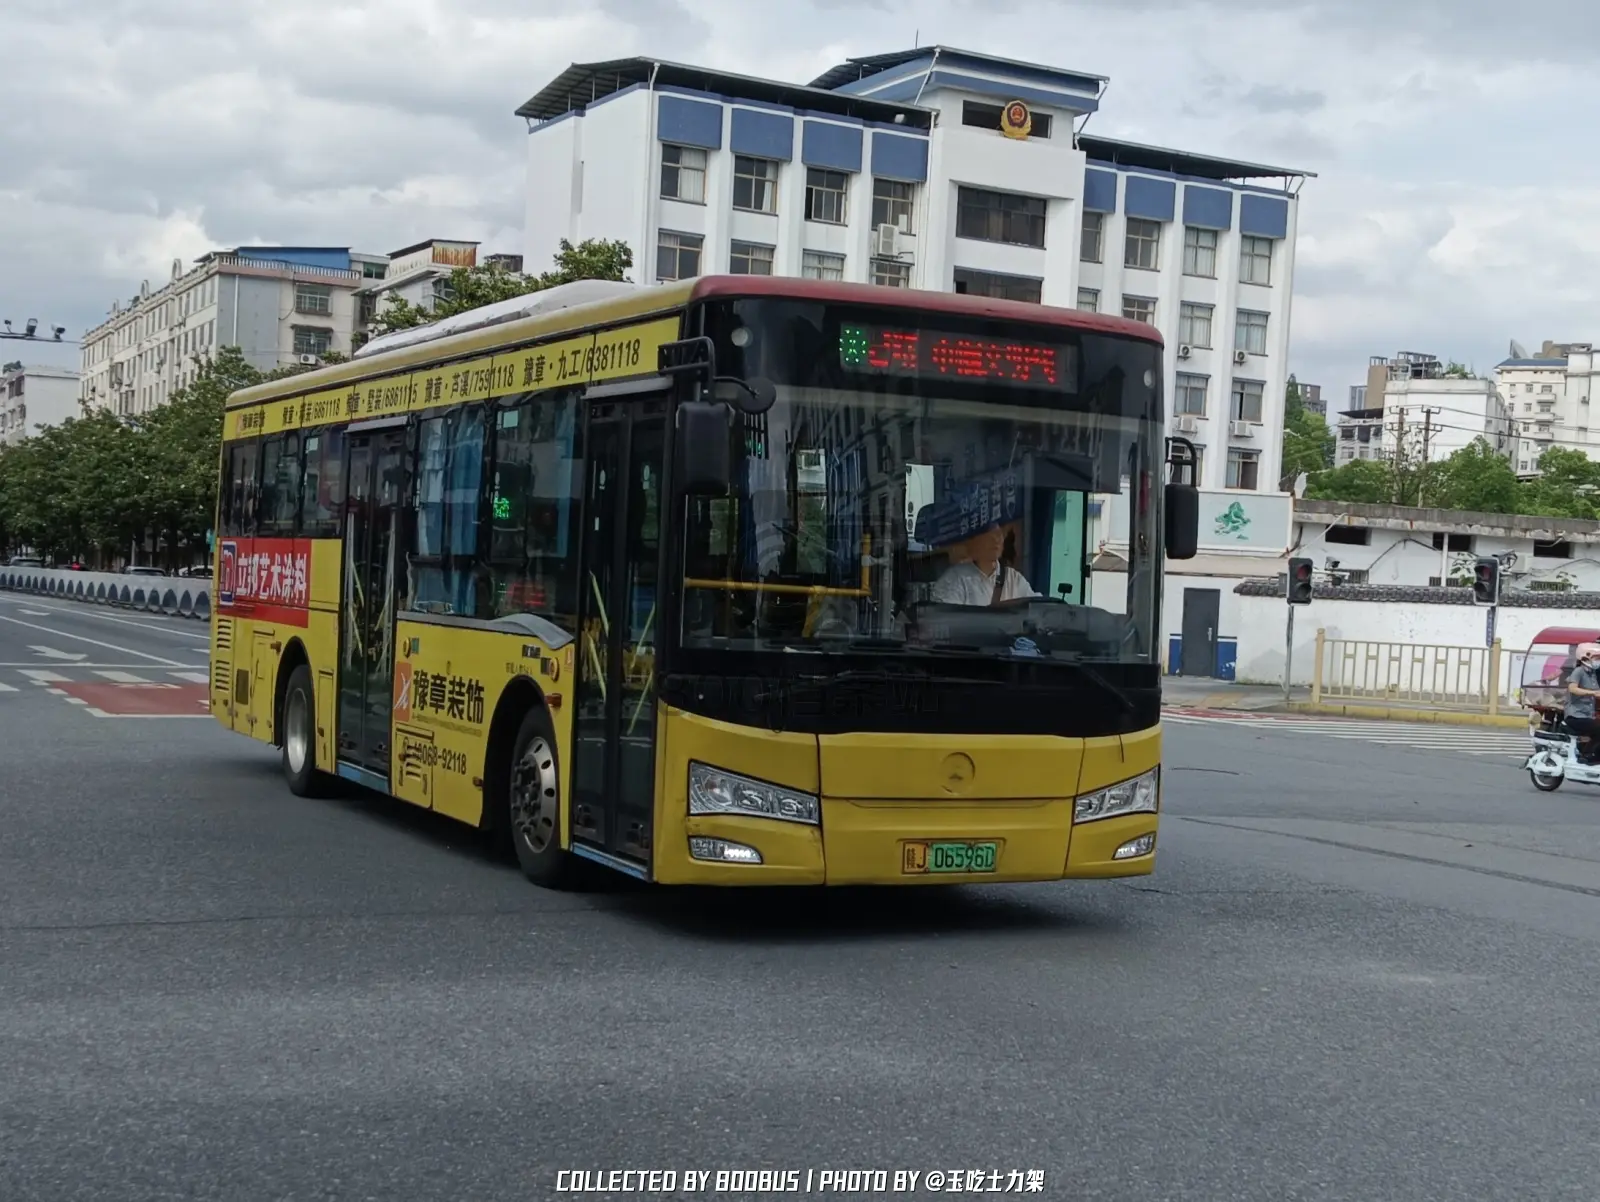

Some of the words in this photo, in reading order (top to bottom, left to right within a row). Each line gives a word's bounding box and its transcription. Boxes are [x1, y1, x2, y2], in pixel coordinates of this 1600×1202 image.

[235, 552, 308, 605] 立邦艺术涂料
[412, 669, 486, 725] 豫章装饰
